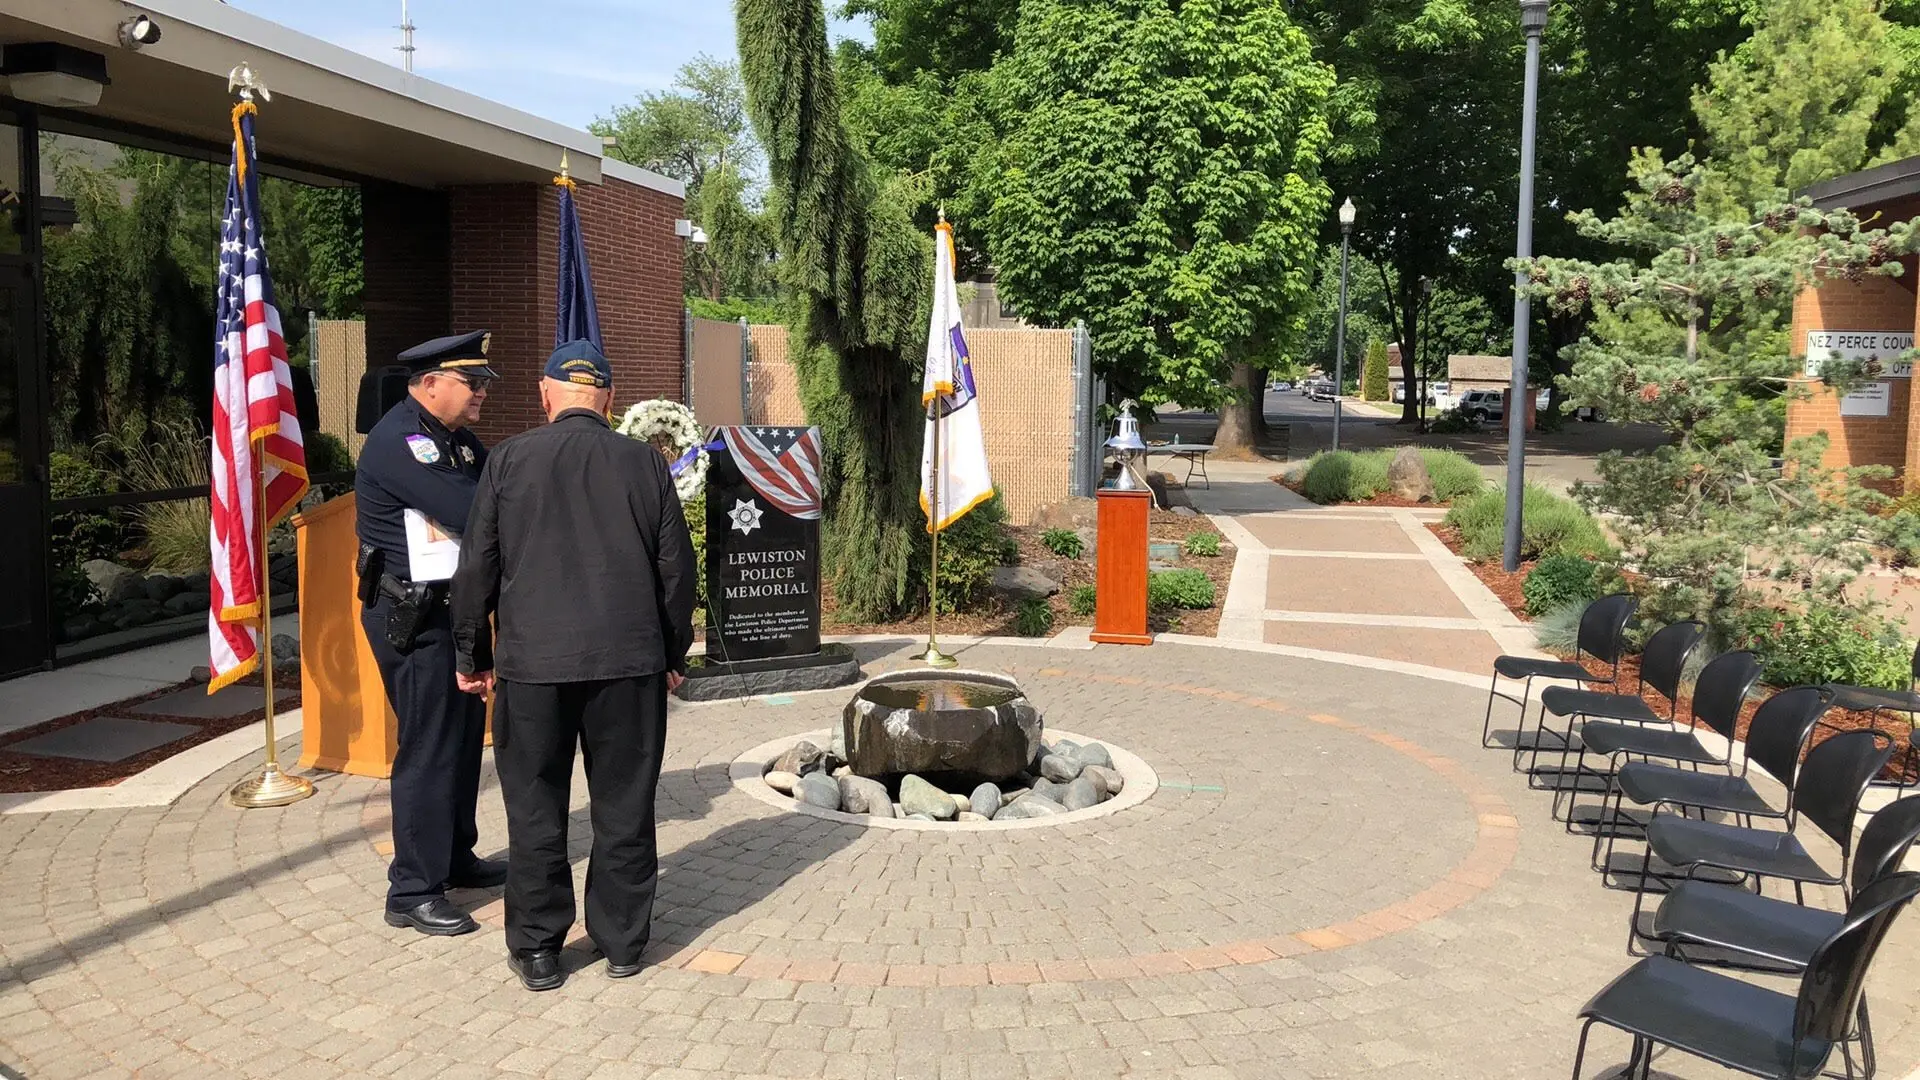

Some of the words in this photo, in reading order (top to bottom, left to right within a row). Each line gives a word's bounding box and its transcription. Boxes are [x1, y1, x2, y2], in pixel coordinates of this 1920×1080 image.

[1809, 335, 1832, 348] NEZ
[1838, 336, 1877, 349] PERCE
[1882, 336, 1914, 350] COUN
[1892, 361, 1912, 374] OFF
[728, 549, 806, 565] LEWISTON
[740, 566, 795, 581] POLICE
[725, 582, 809, 599] MEMORIAL
[729, 612, 756, 620] Dedicated
[775, 609, 798, 617] members
